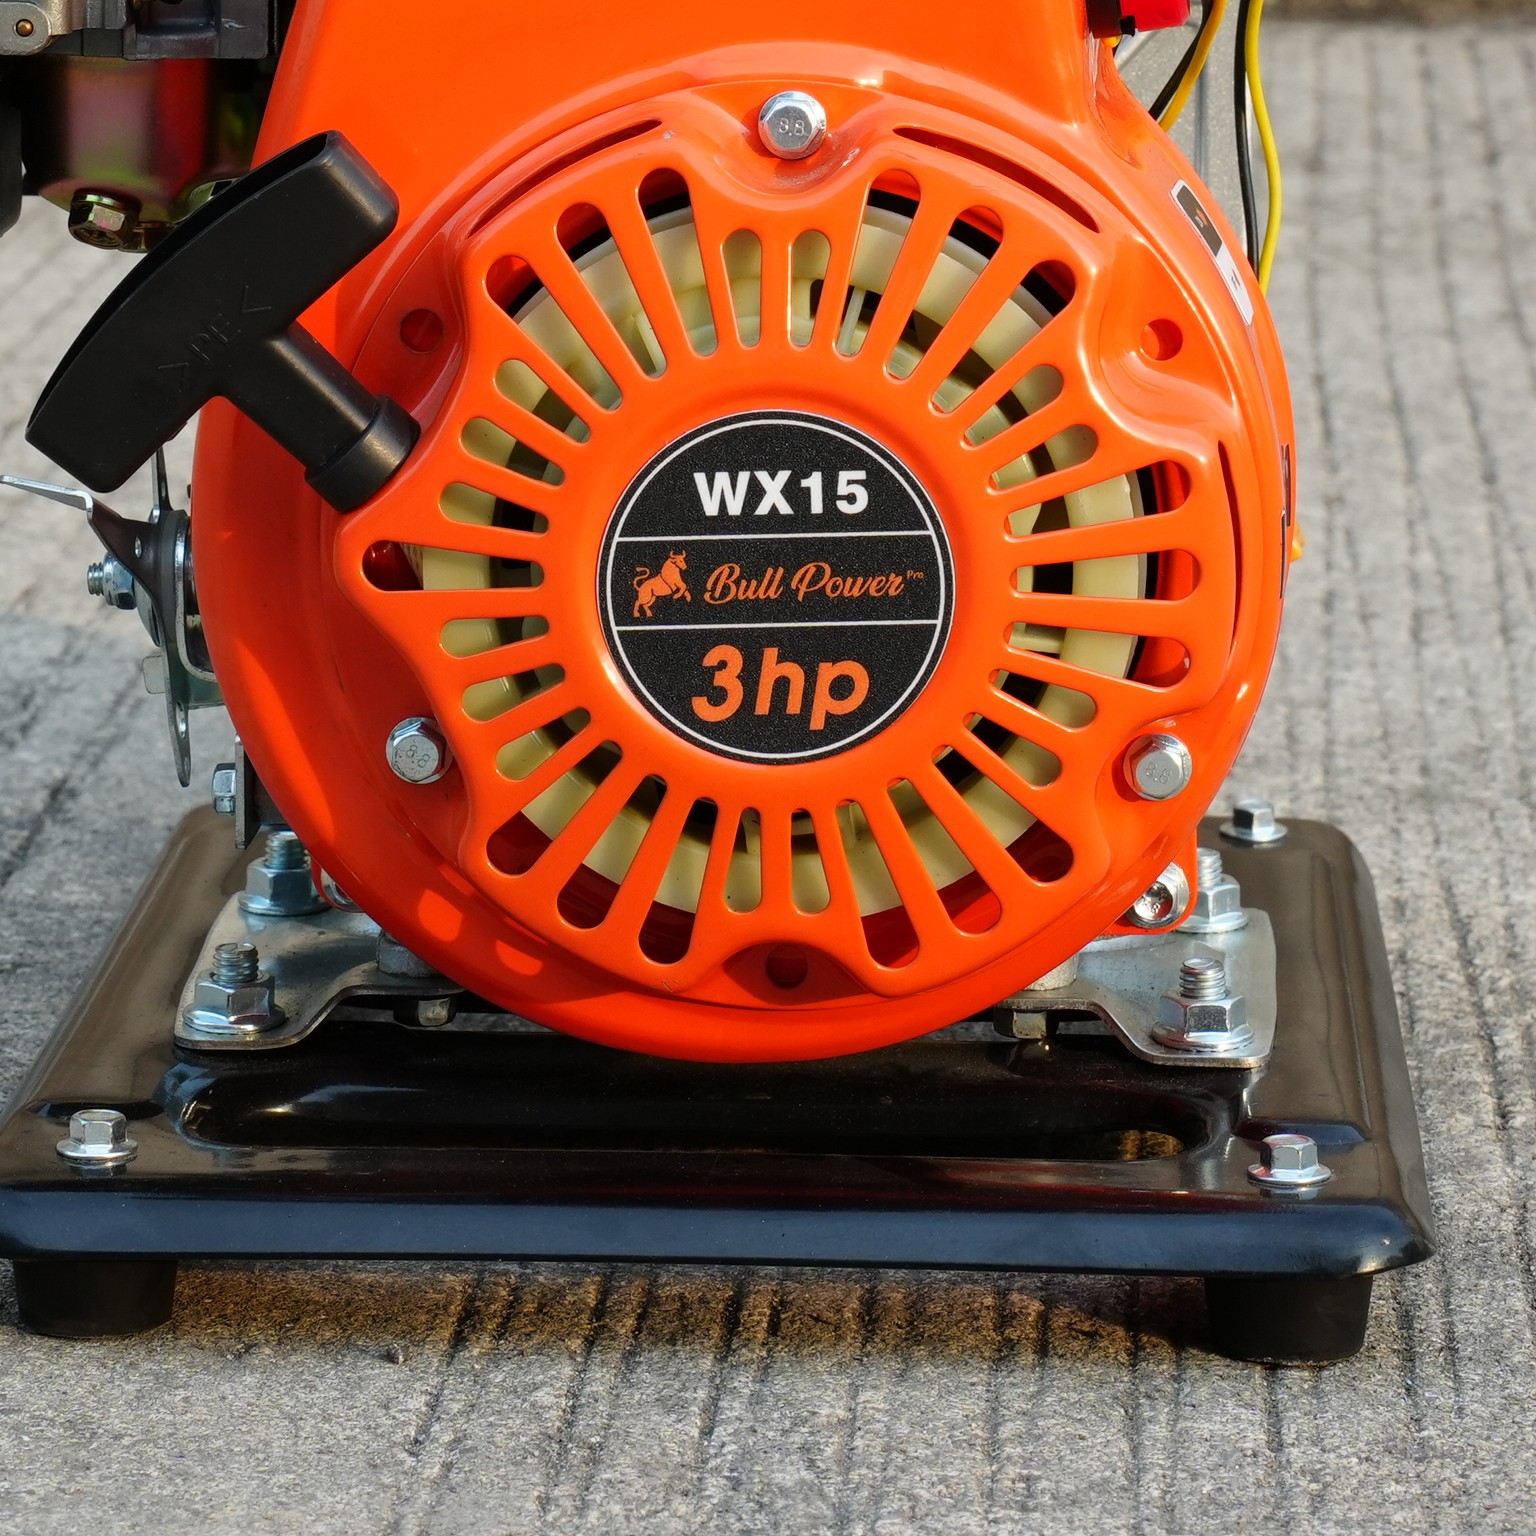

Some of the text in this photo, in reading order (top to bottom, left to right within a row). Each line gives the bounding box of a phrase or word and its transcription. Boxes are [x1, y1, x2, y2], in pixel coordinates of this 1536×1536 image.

[693, 470, 869, 516] WX15
[703, 563, 785, 605] Bull
[790, 561, 905, 603] Power
[691, 644, 870, 731] 3hp
